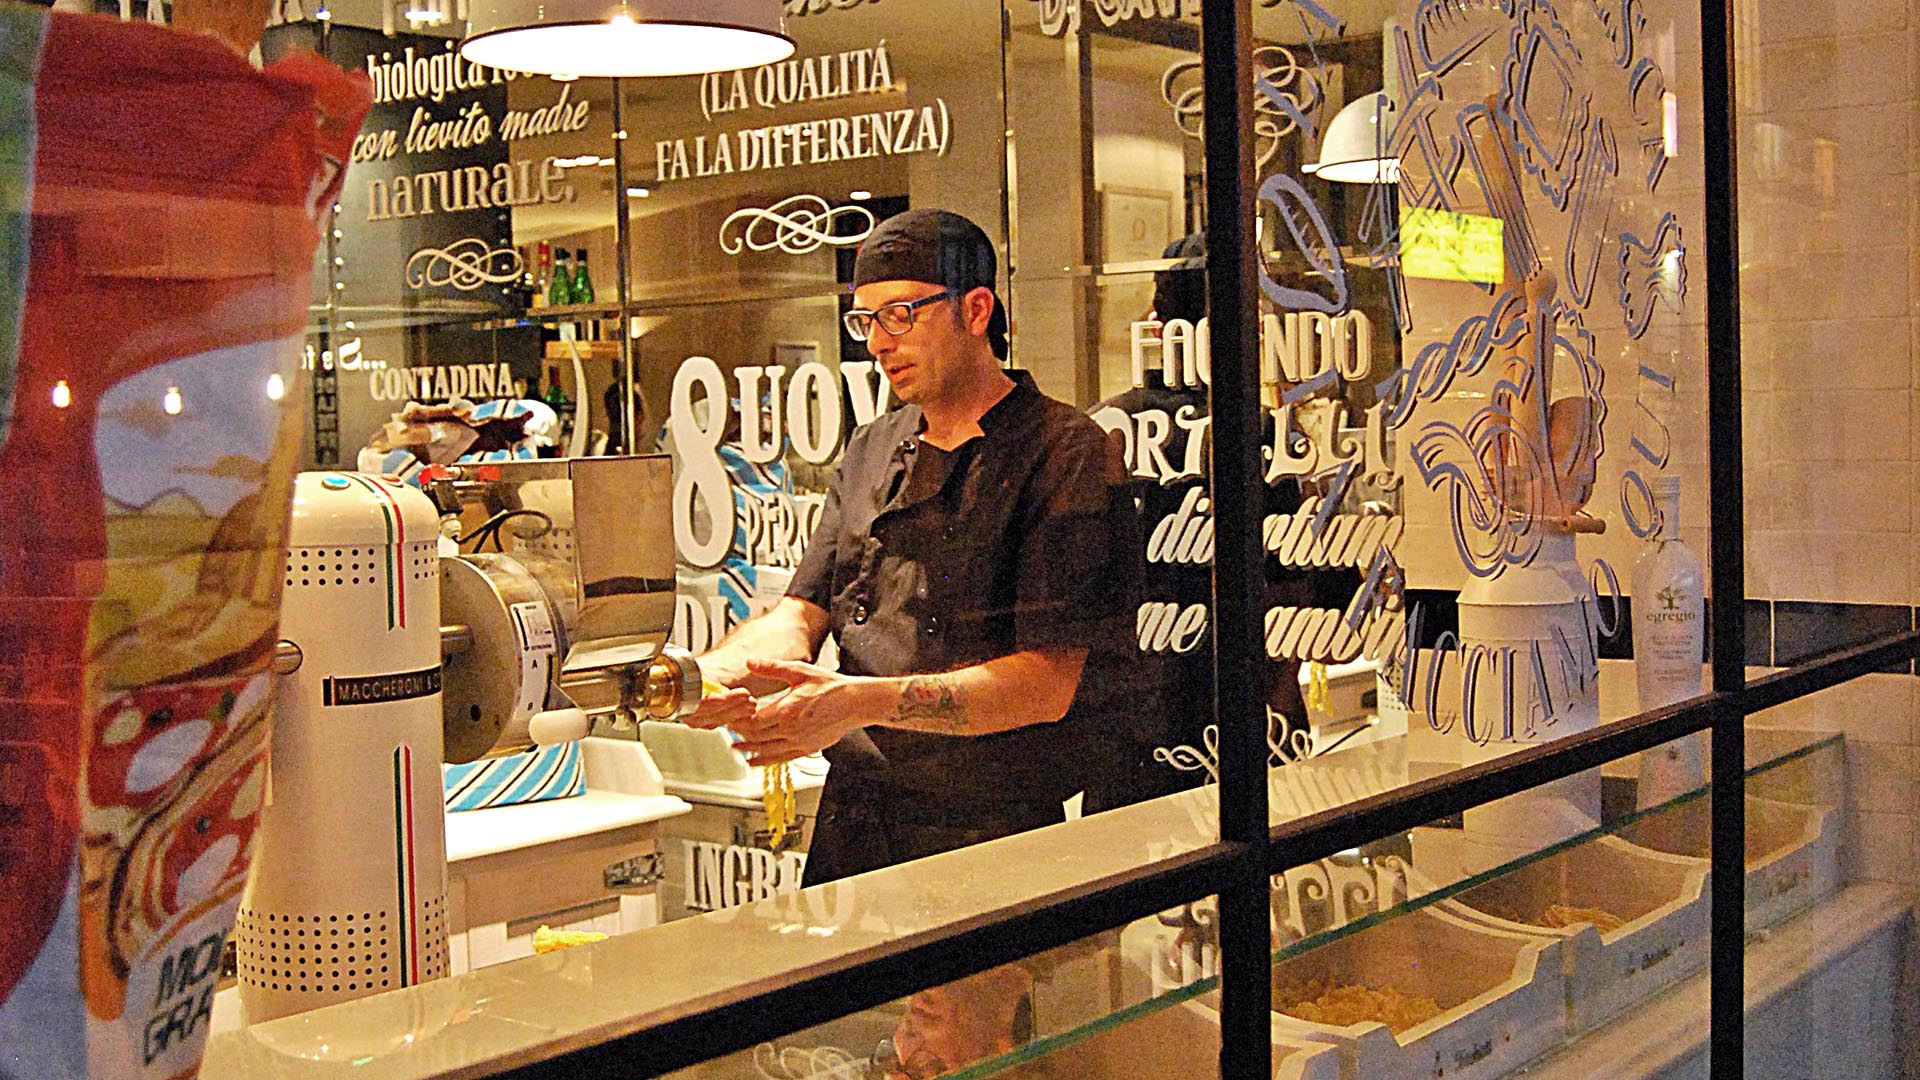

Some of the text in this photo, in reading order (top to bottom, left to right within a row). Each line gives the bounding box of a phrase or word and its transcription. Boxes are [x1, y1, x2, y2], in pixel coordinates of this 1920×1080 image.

[352, 85, 590, 163] con lievito madre
[700, 70, 748, 122] (LA
[656, 98, 950, 182] FA LA DIFFERENZA)
[671, 357, 890, 566] 8 UOV
[338, 676, 423, 700] MACCHERONI
